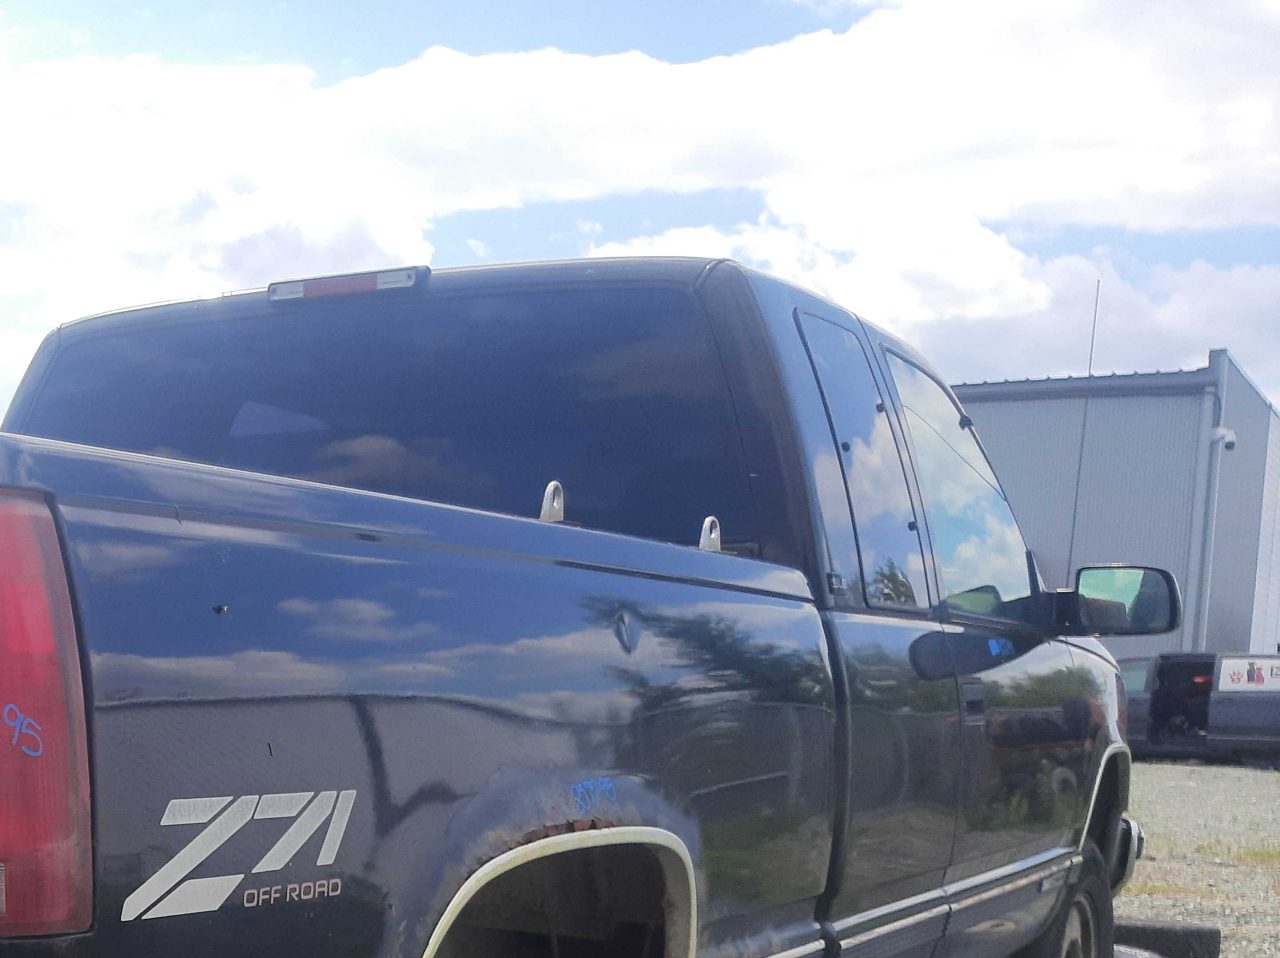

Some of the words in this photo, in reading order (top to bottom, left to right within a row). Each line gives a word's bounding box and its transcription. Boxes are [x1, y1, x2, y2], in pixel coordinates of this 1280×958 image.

[120, 789, 357, 922] Z71
[243, 885, 282, 908] OFF
[286, 878, 342, 902] ROAD
